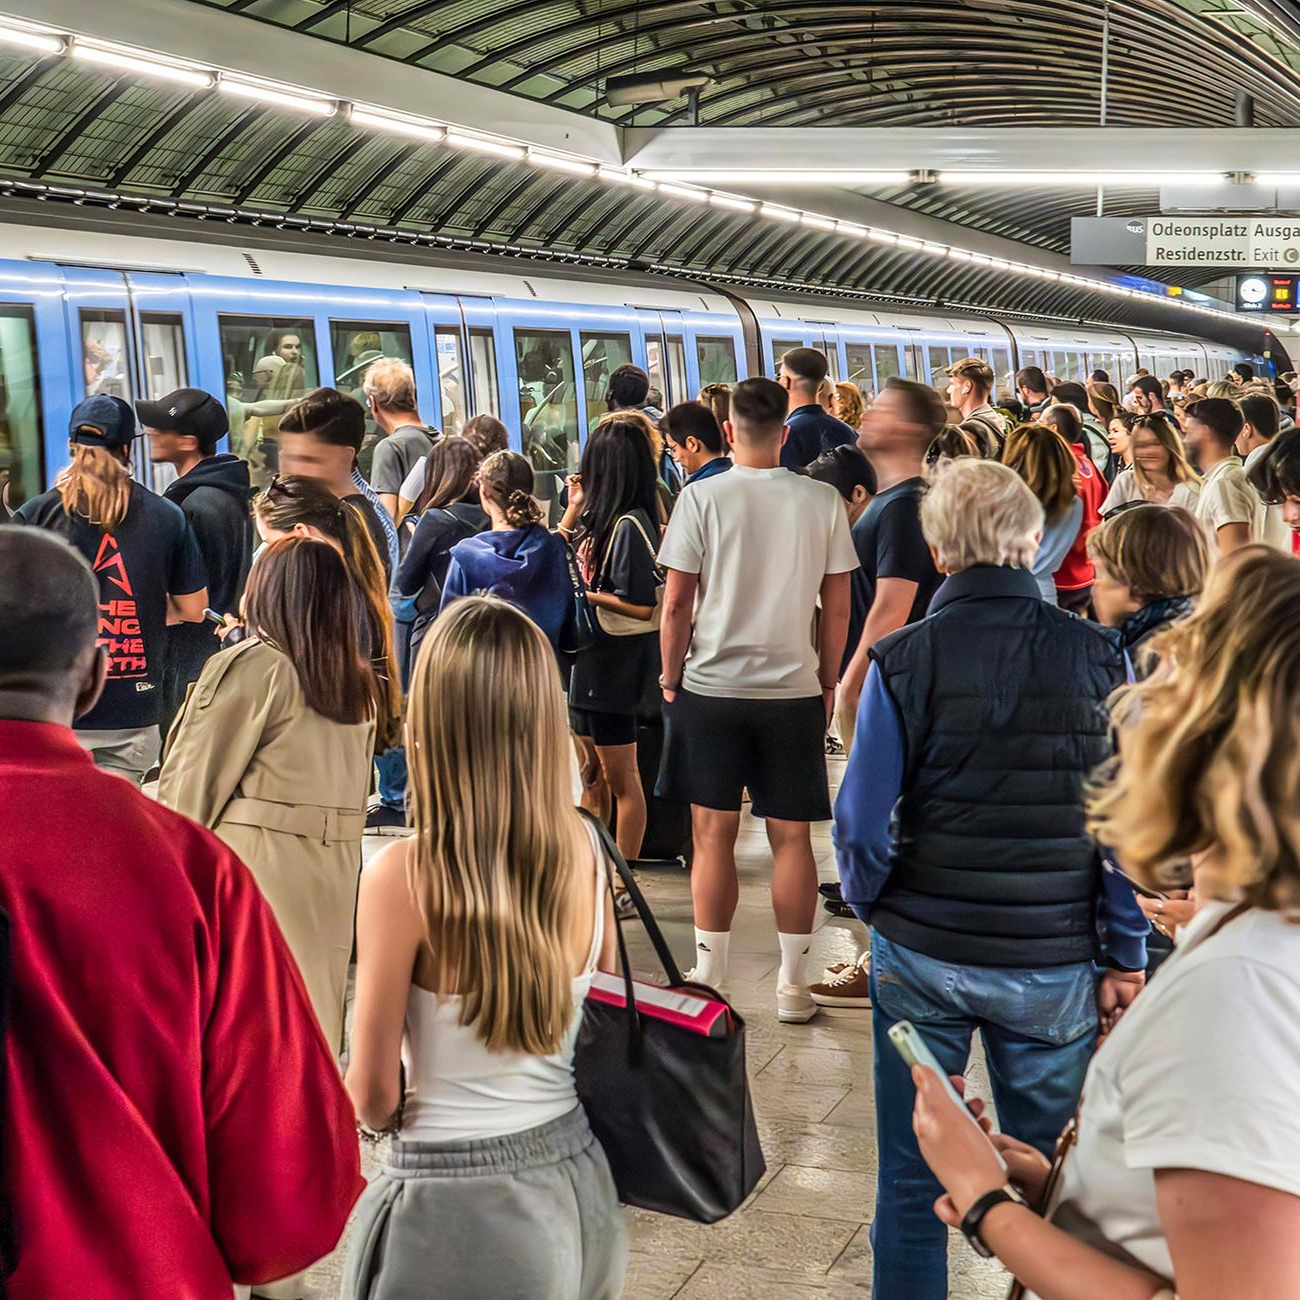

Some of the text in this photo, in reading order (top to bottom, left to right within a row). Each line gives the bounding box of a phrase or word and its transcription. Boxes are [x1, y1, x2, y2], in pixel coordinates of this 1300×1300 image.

[1153, 222, 1247, 240] Odeonsplatz
[1156, 247, 1246, 261] Residenzstr.
[1254, 247, 1279, 261] Exit
